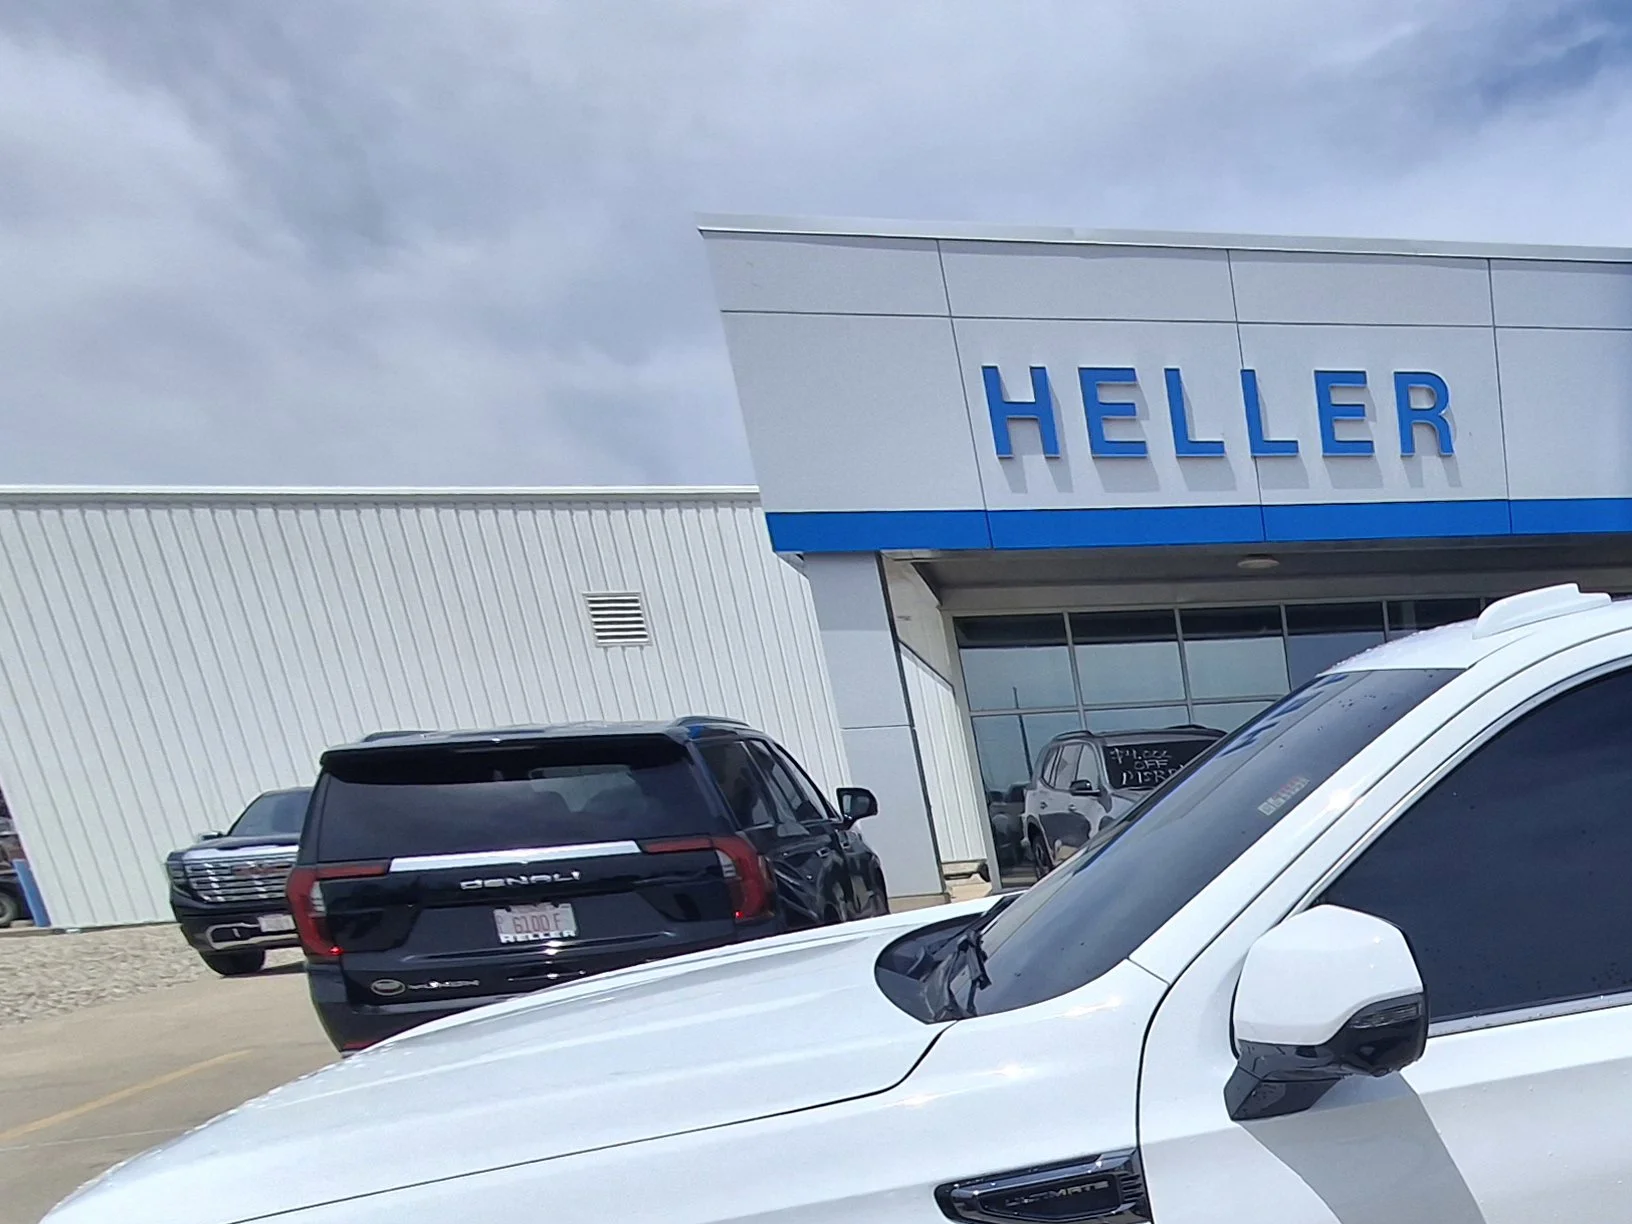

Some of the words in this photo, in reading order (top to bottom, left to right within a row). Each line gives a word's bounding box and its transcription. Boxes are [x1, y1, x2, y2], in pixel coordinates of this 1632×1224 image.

[980, 364, 1455, 458] HELLER
[1134, 759, 1169, 770] OFF
[460, 871, 580, 890] DENALI
